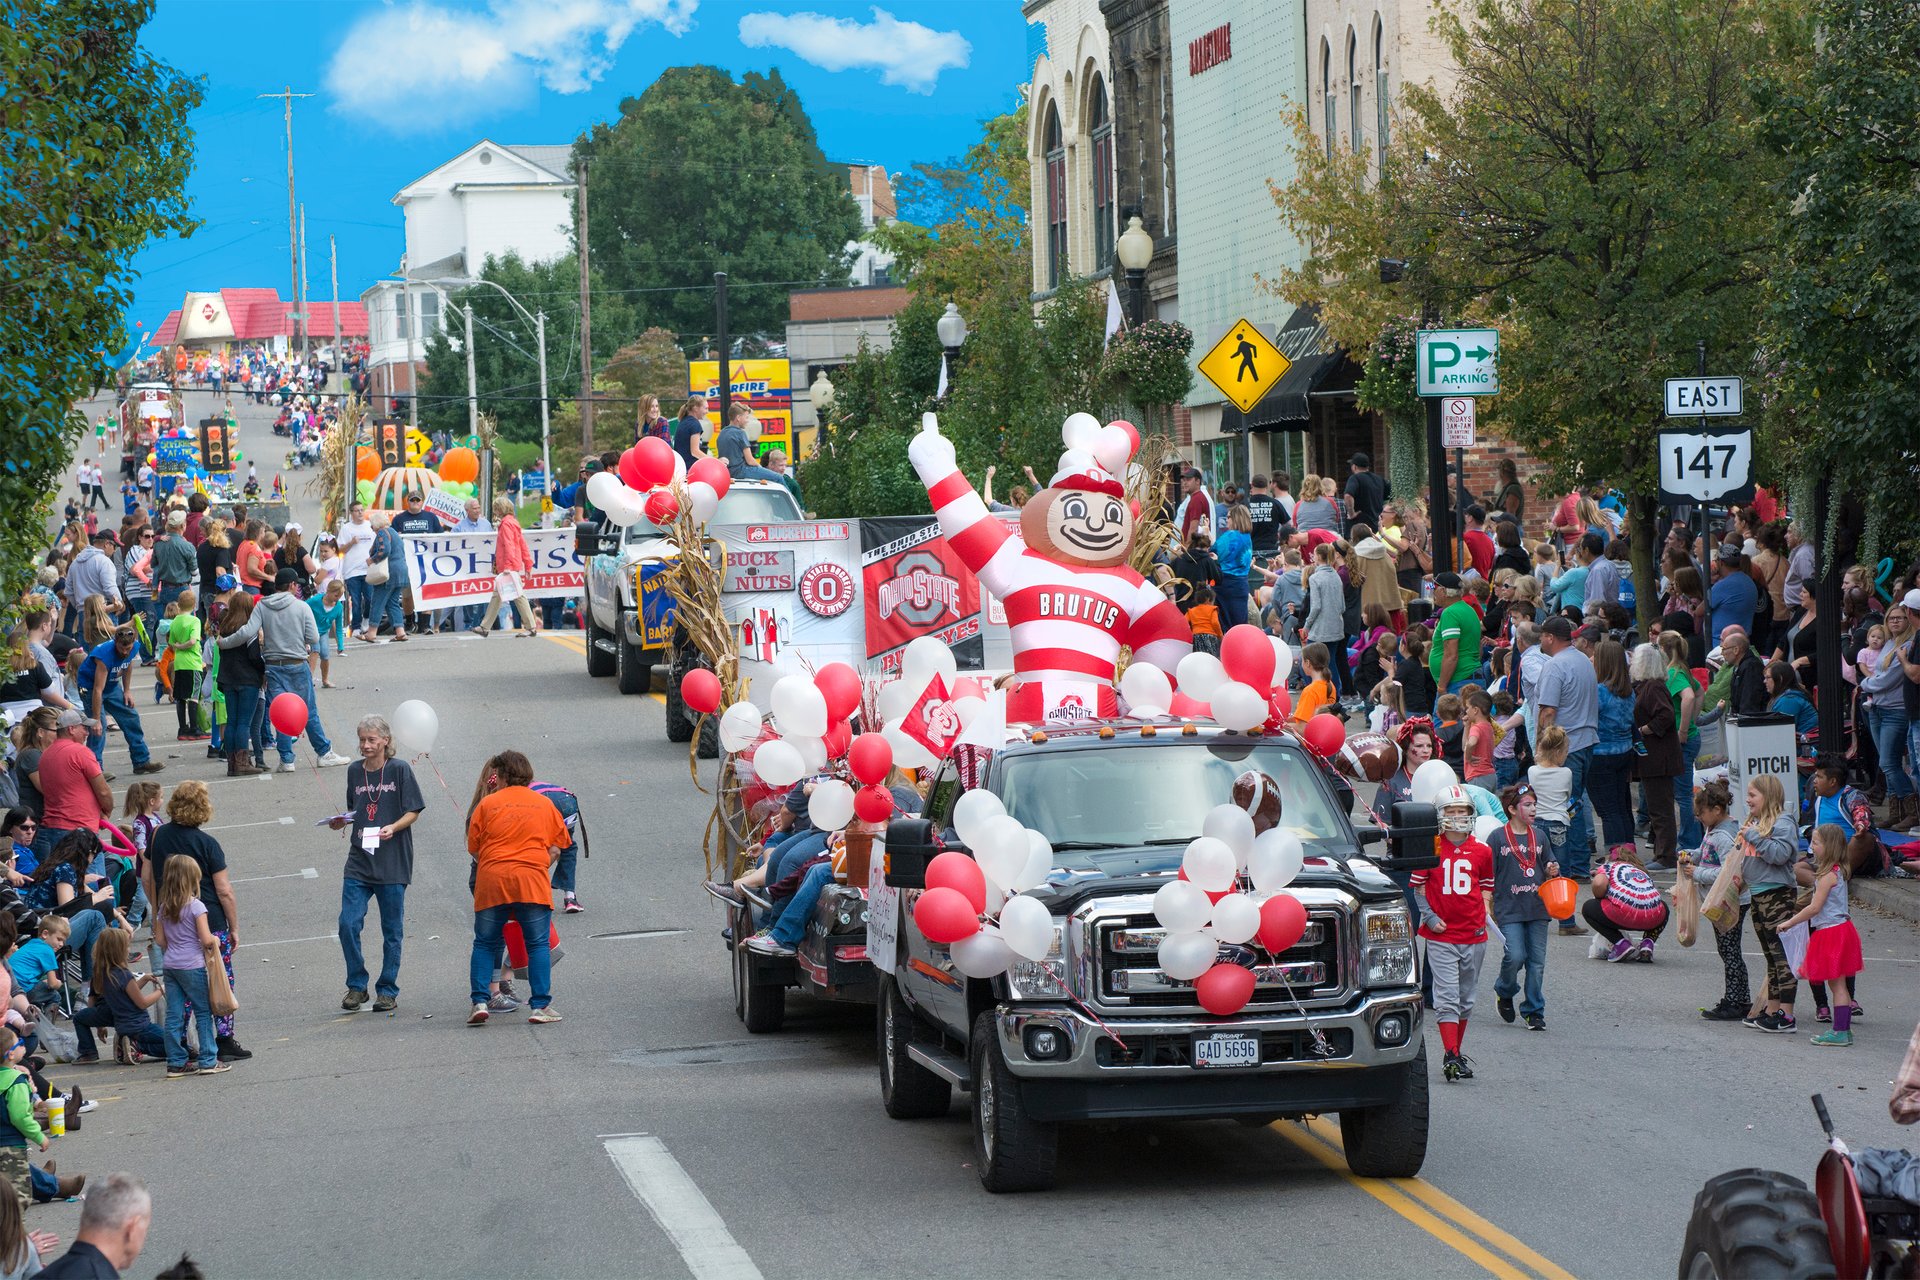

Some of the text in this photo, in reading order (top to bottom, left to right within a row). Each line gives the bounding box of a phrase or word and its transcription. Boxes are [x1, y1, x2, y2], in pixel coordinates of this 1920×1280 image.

[709, 382, 765, 397] STRFIRE
[1678, 386, 1730, 407] EAST
[1674, 444, 1736, 480] 147
[414, 540, 473, 554] BILL
[867, 524, 939, 558] THE OHIO STA
[727, 552, 779, 566] BUCK
[532, 575, 565, 587] THE
[735, 575, 791, 590] NUTS
[807, 565, 828, 579] STATE
[830, 565, 852, 600] BUCKEYES
[1040, 593, 1119, 629] BRUTUS
[1748, 756, 1790, 775] PITCH
[1443, 858, 1472, 895] 16
[1199, 1041, 1255, 1058] GAD 5696
